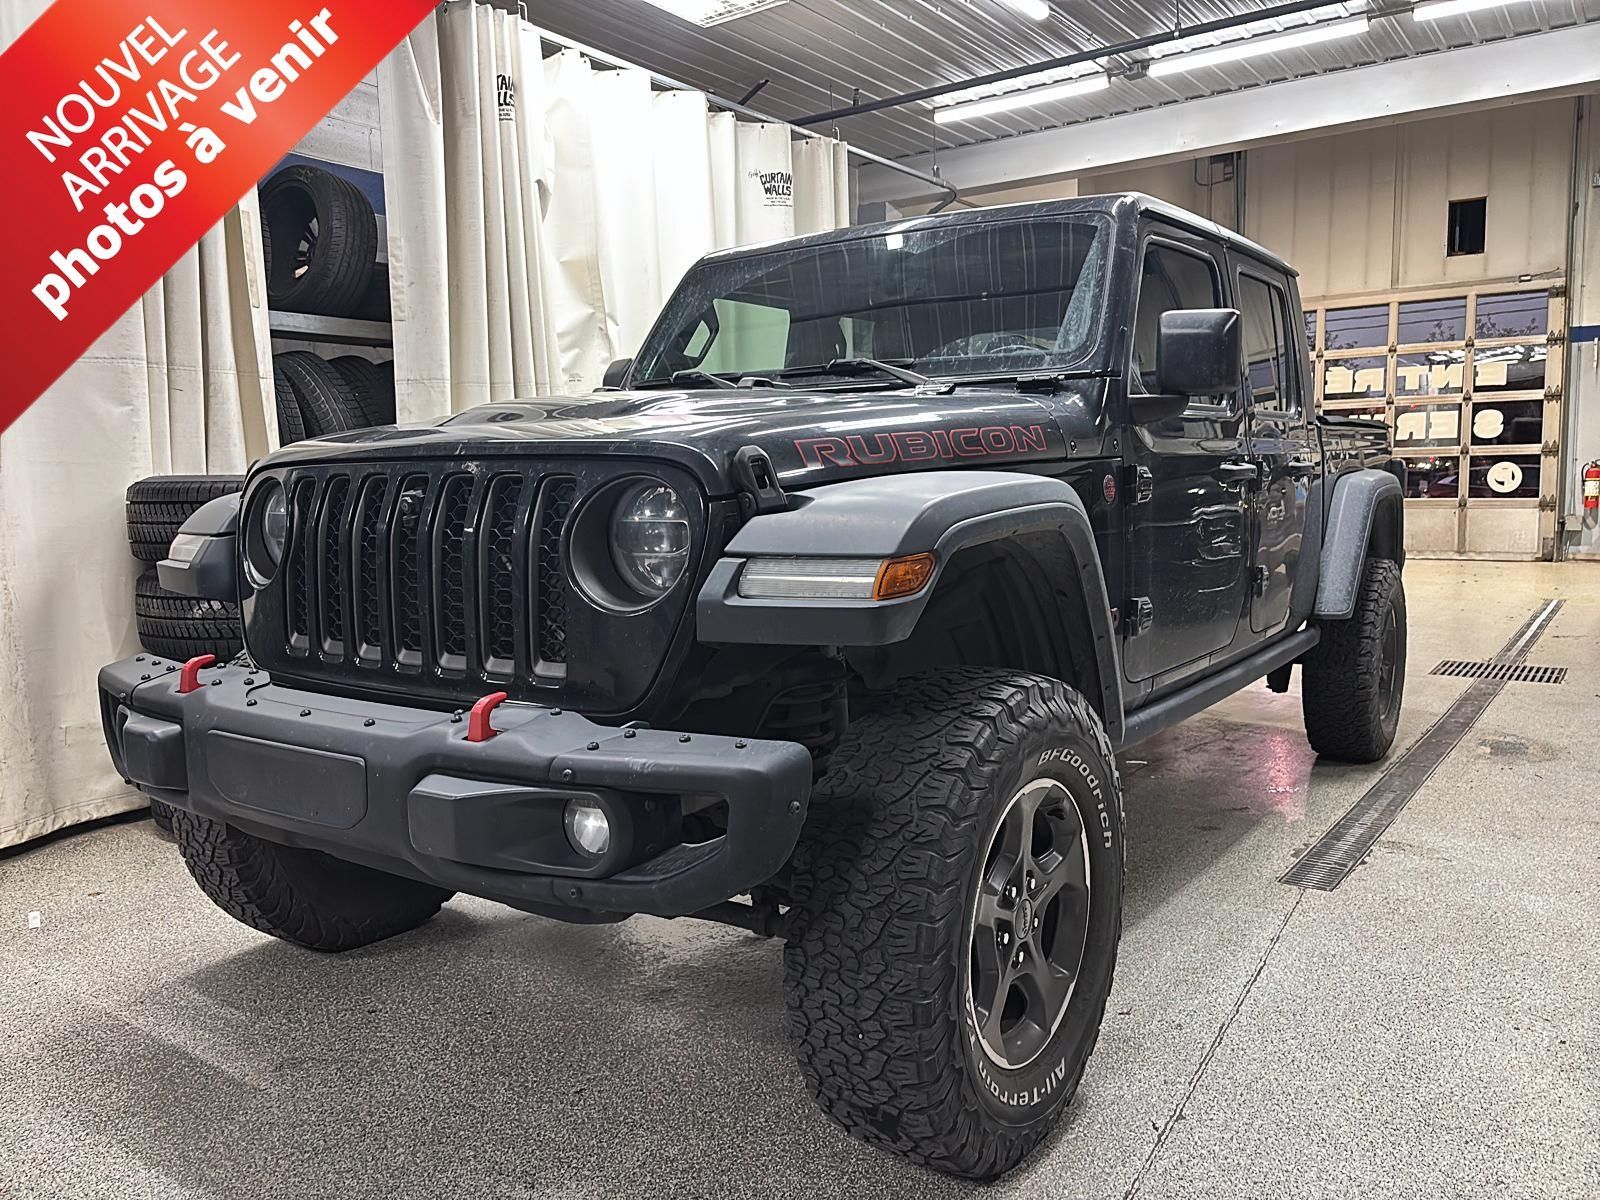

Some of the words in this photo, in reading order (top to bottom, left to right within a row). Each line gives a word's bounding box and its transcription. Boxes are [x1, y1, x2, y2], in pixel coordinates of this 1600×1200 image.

[760, 171, 793, 186] CURTAIN
[763, 184, 792, 196] WALLS
[793, 425, 1047, 468] RUBICON
[1037, 748, 1112, 849] BFGoodrich
